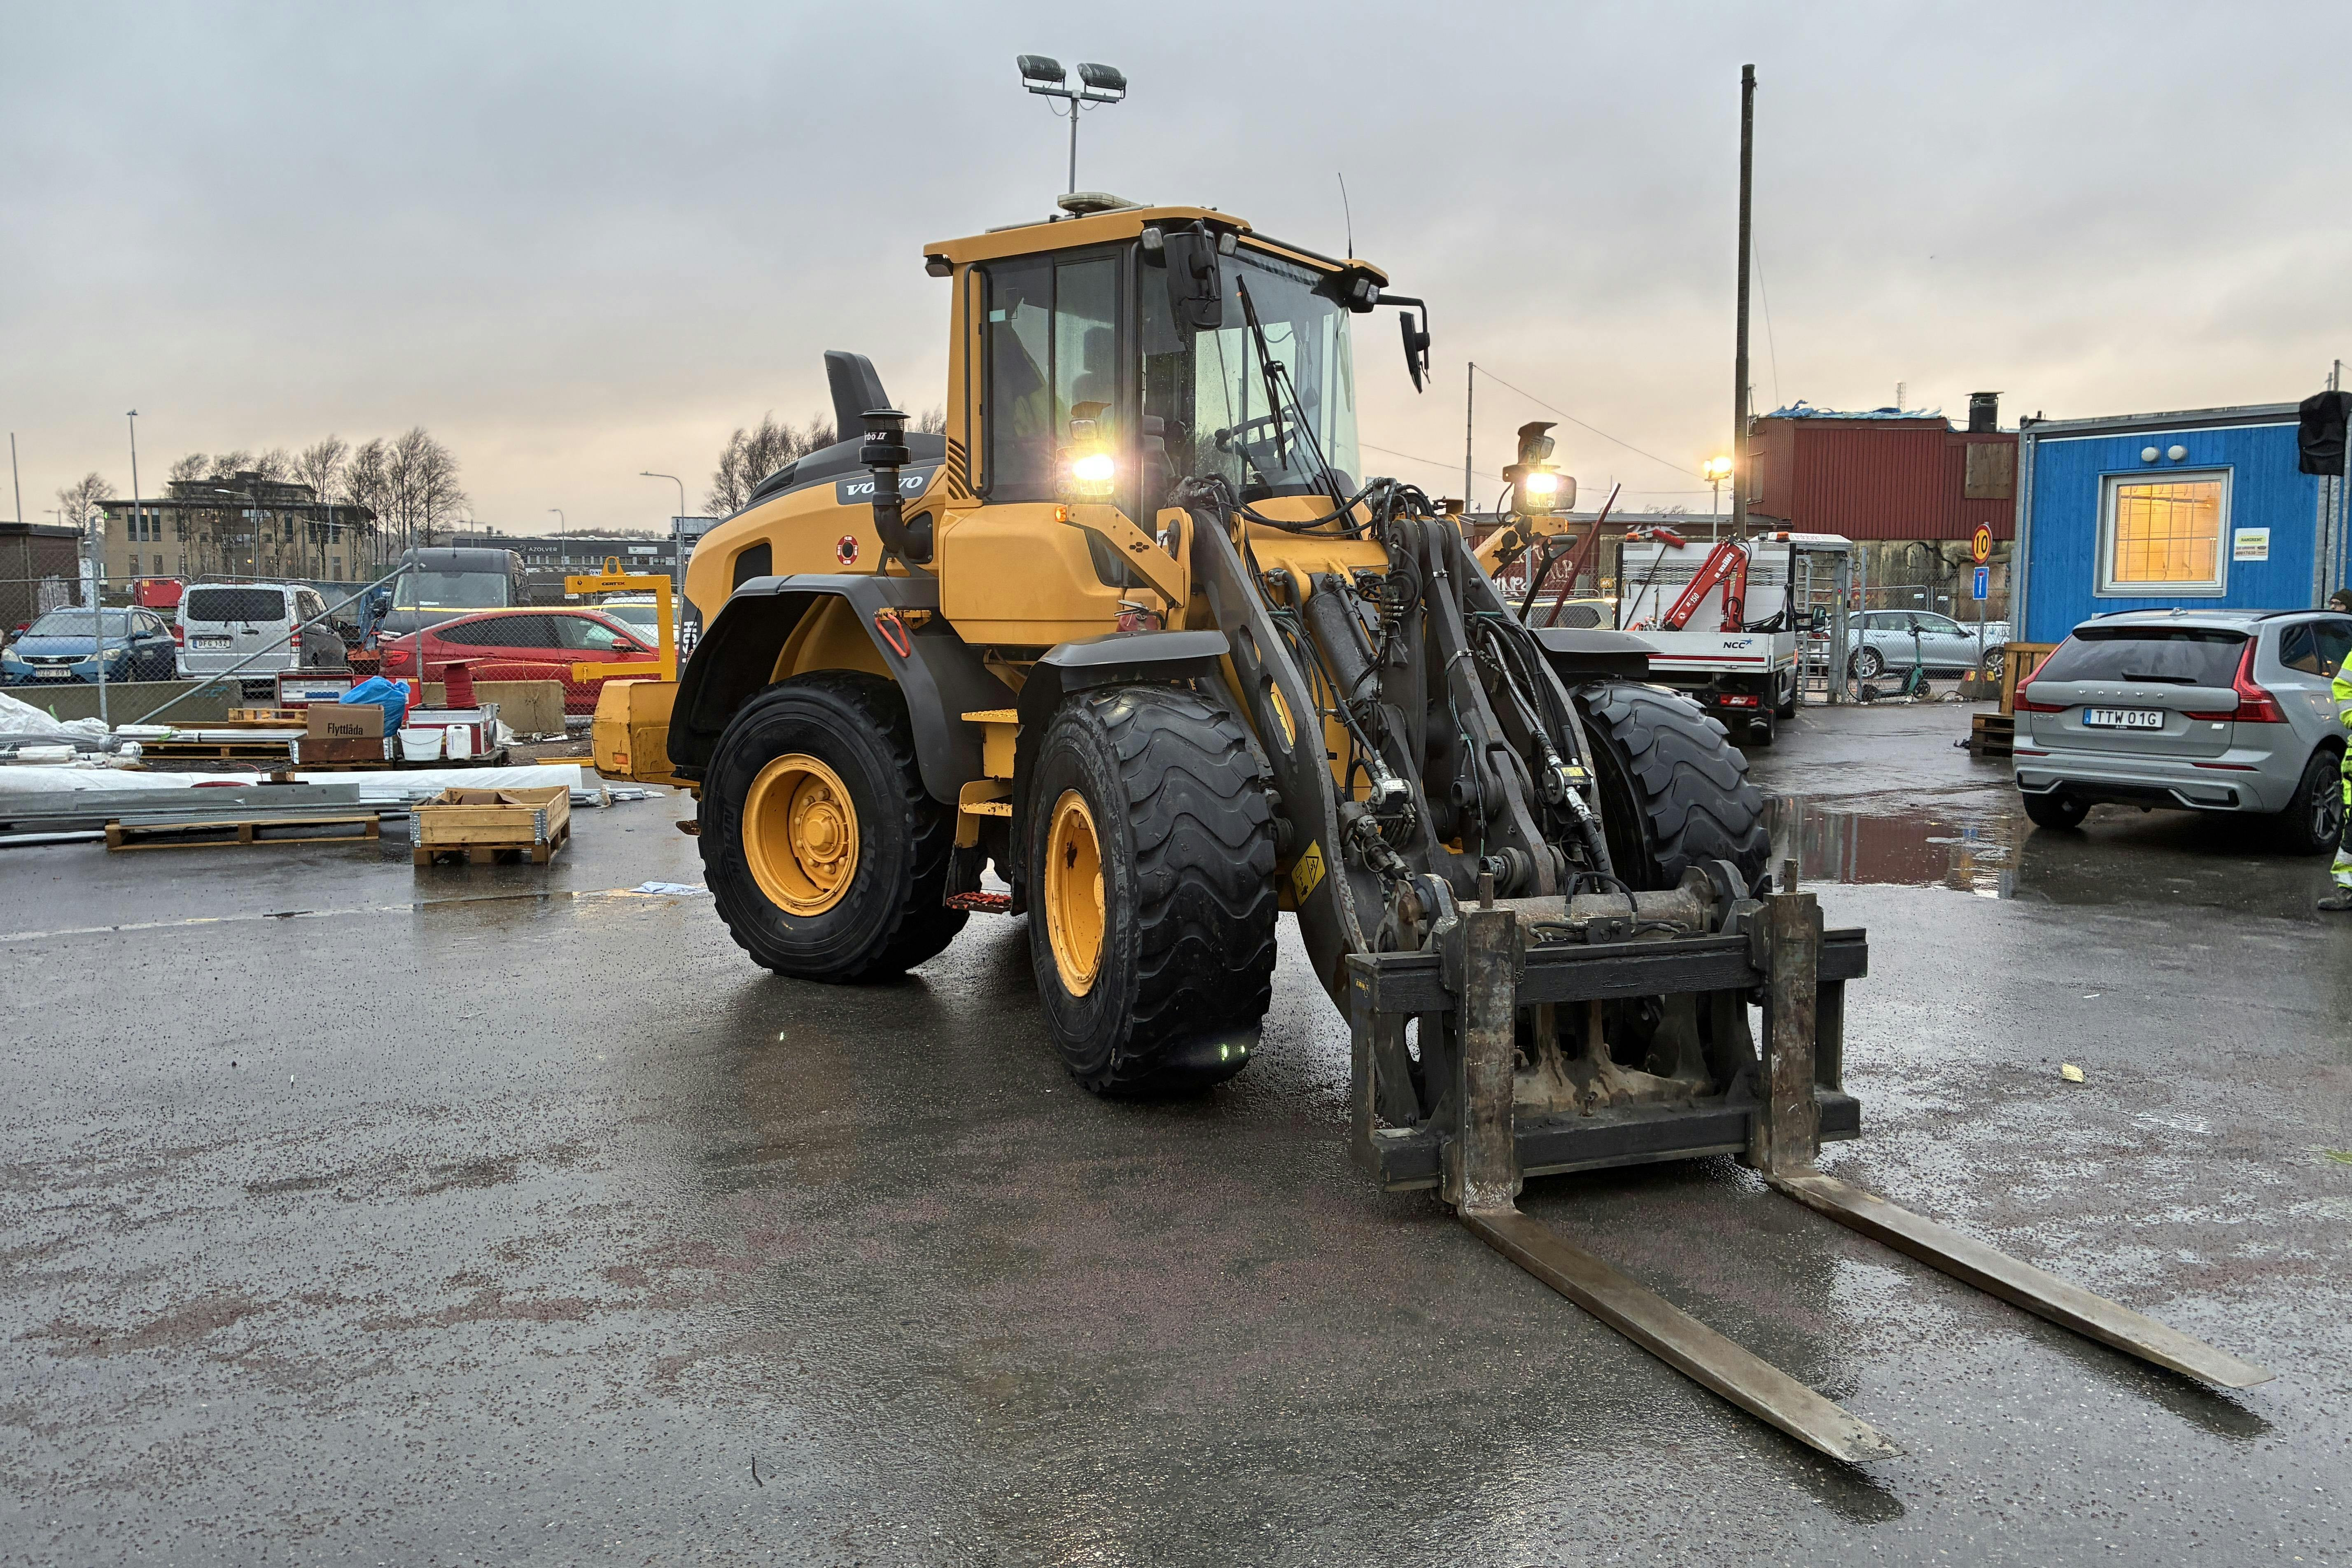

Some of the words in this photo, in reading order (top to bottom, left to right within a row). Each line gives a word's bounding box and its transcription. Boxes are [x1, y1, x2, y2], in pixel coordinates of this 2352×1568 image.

[846, 476, 923, 495] VOVO
[1976, 535, 1988, 554] 10
[1690, 593, 1699, 603] 150
[2096, 711, 2123, 723] TTW
[2128, 712, 2156, 725] 01G
[328, 723, 363, 736] Flyttlåda
